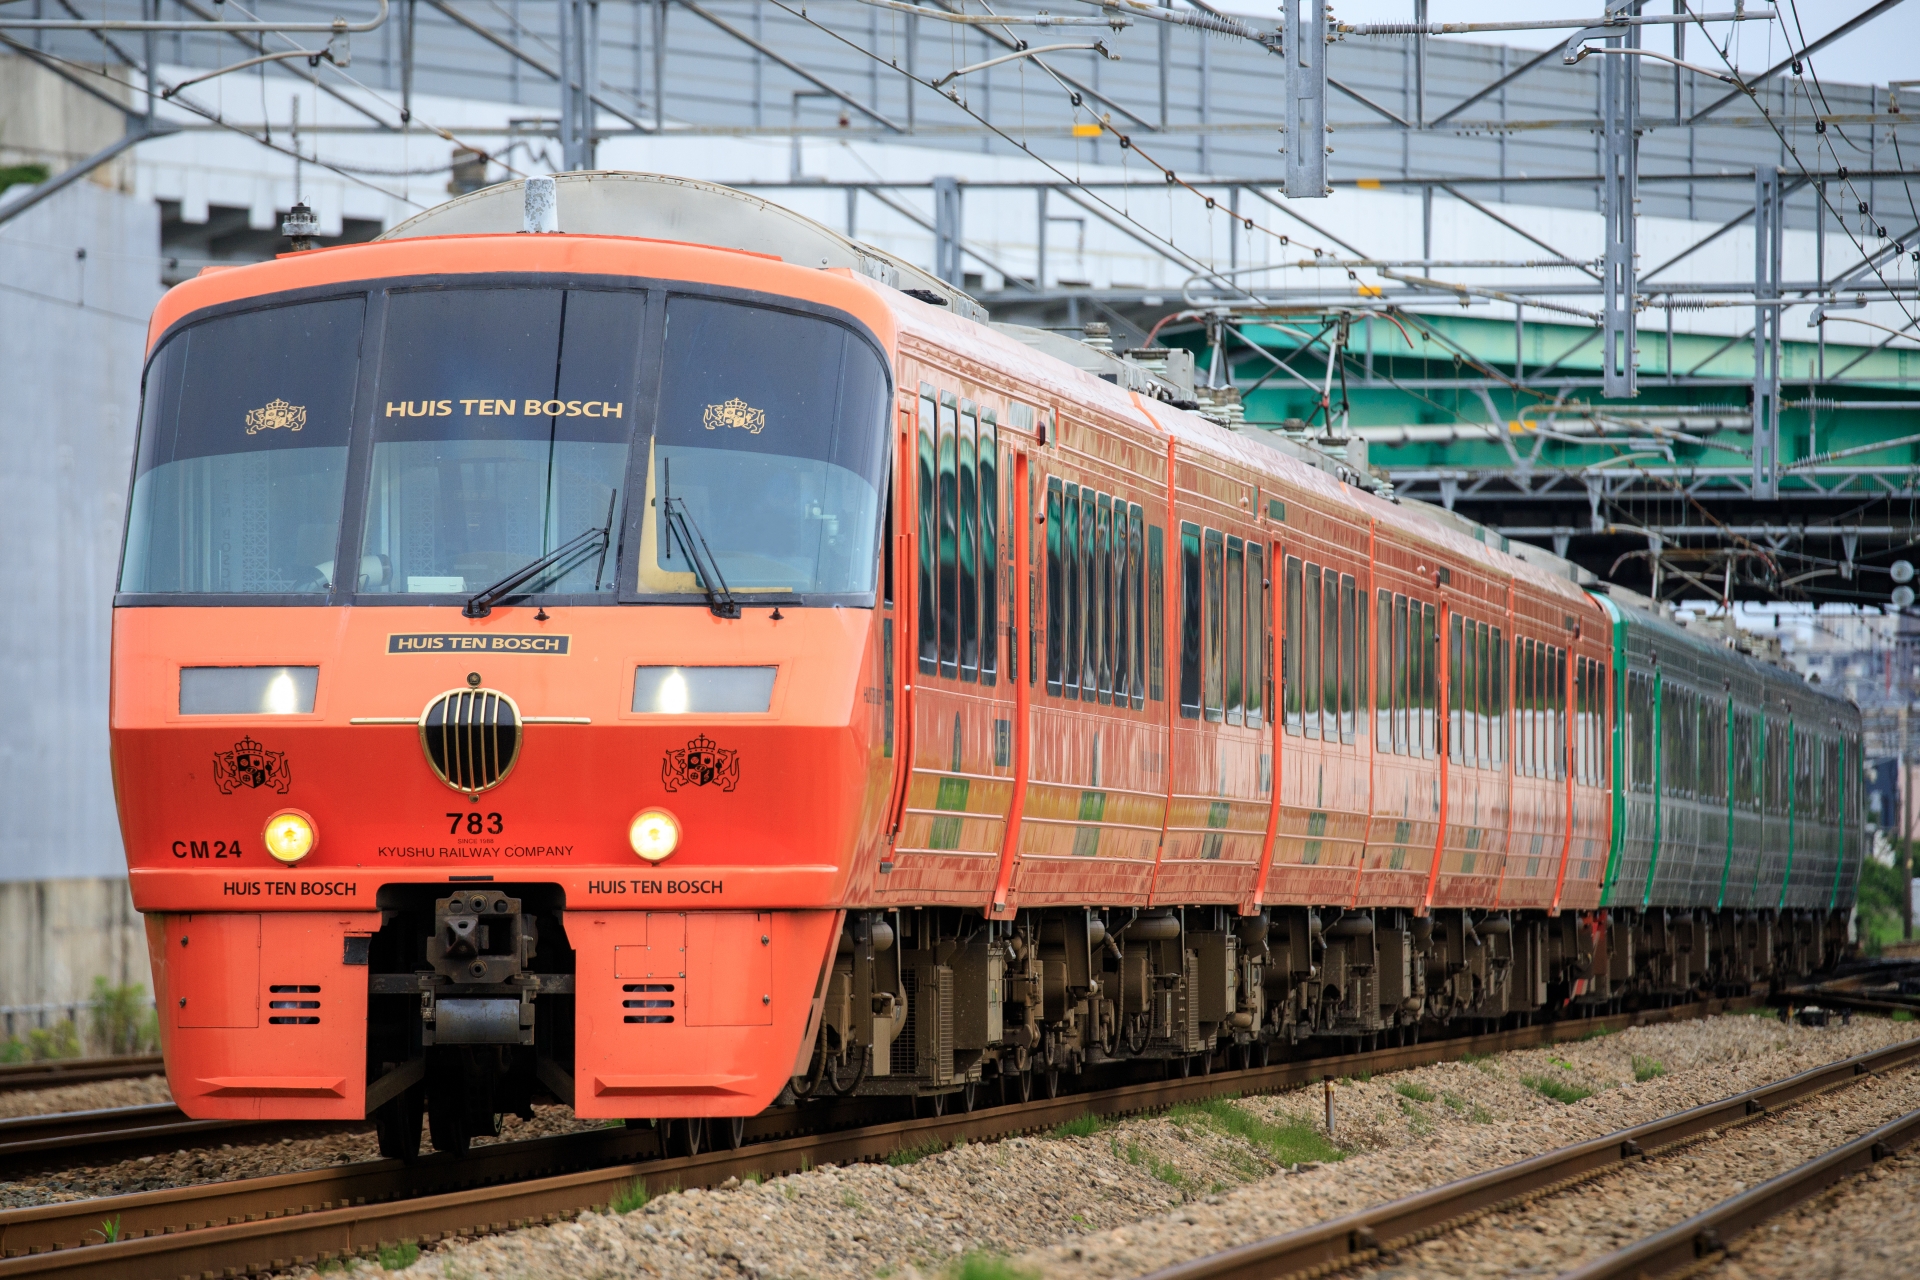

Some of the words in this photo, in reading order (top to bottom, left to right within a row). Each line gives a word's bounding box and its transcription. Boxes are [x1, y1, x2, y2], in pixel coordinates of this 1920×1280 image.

[385, 400, 453, 417] HUIS
[459, 399, 516, 416] TEN
[523, 399, 623, 418] BOSCH
[398, 637, 444, 650] HUIS
[448, 637, 487, 649] TEN
[491, 638, 560, 650] BOSCH
[446, 812, 504, 835] 783
[378, 847, 435, 858] KYUSHU
[439, 847, 501, 858] RAILWAY
[504, 845, 574, 858] COMPANY
[223, 882, 261, 896] HUIS
[265, 882, 296, 895] TEN
[301, 882, 357, 896] BOSCH
[588, 880, 627, 894] HUIS
[630, 880, 662, 894] TEN
[667, 880, 723, 894] BOSCH
